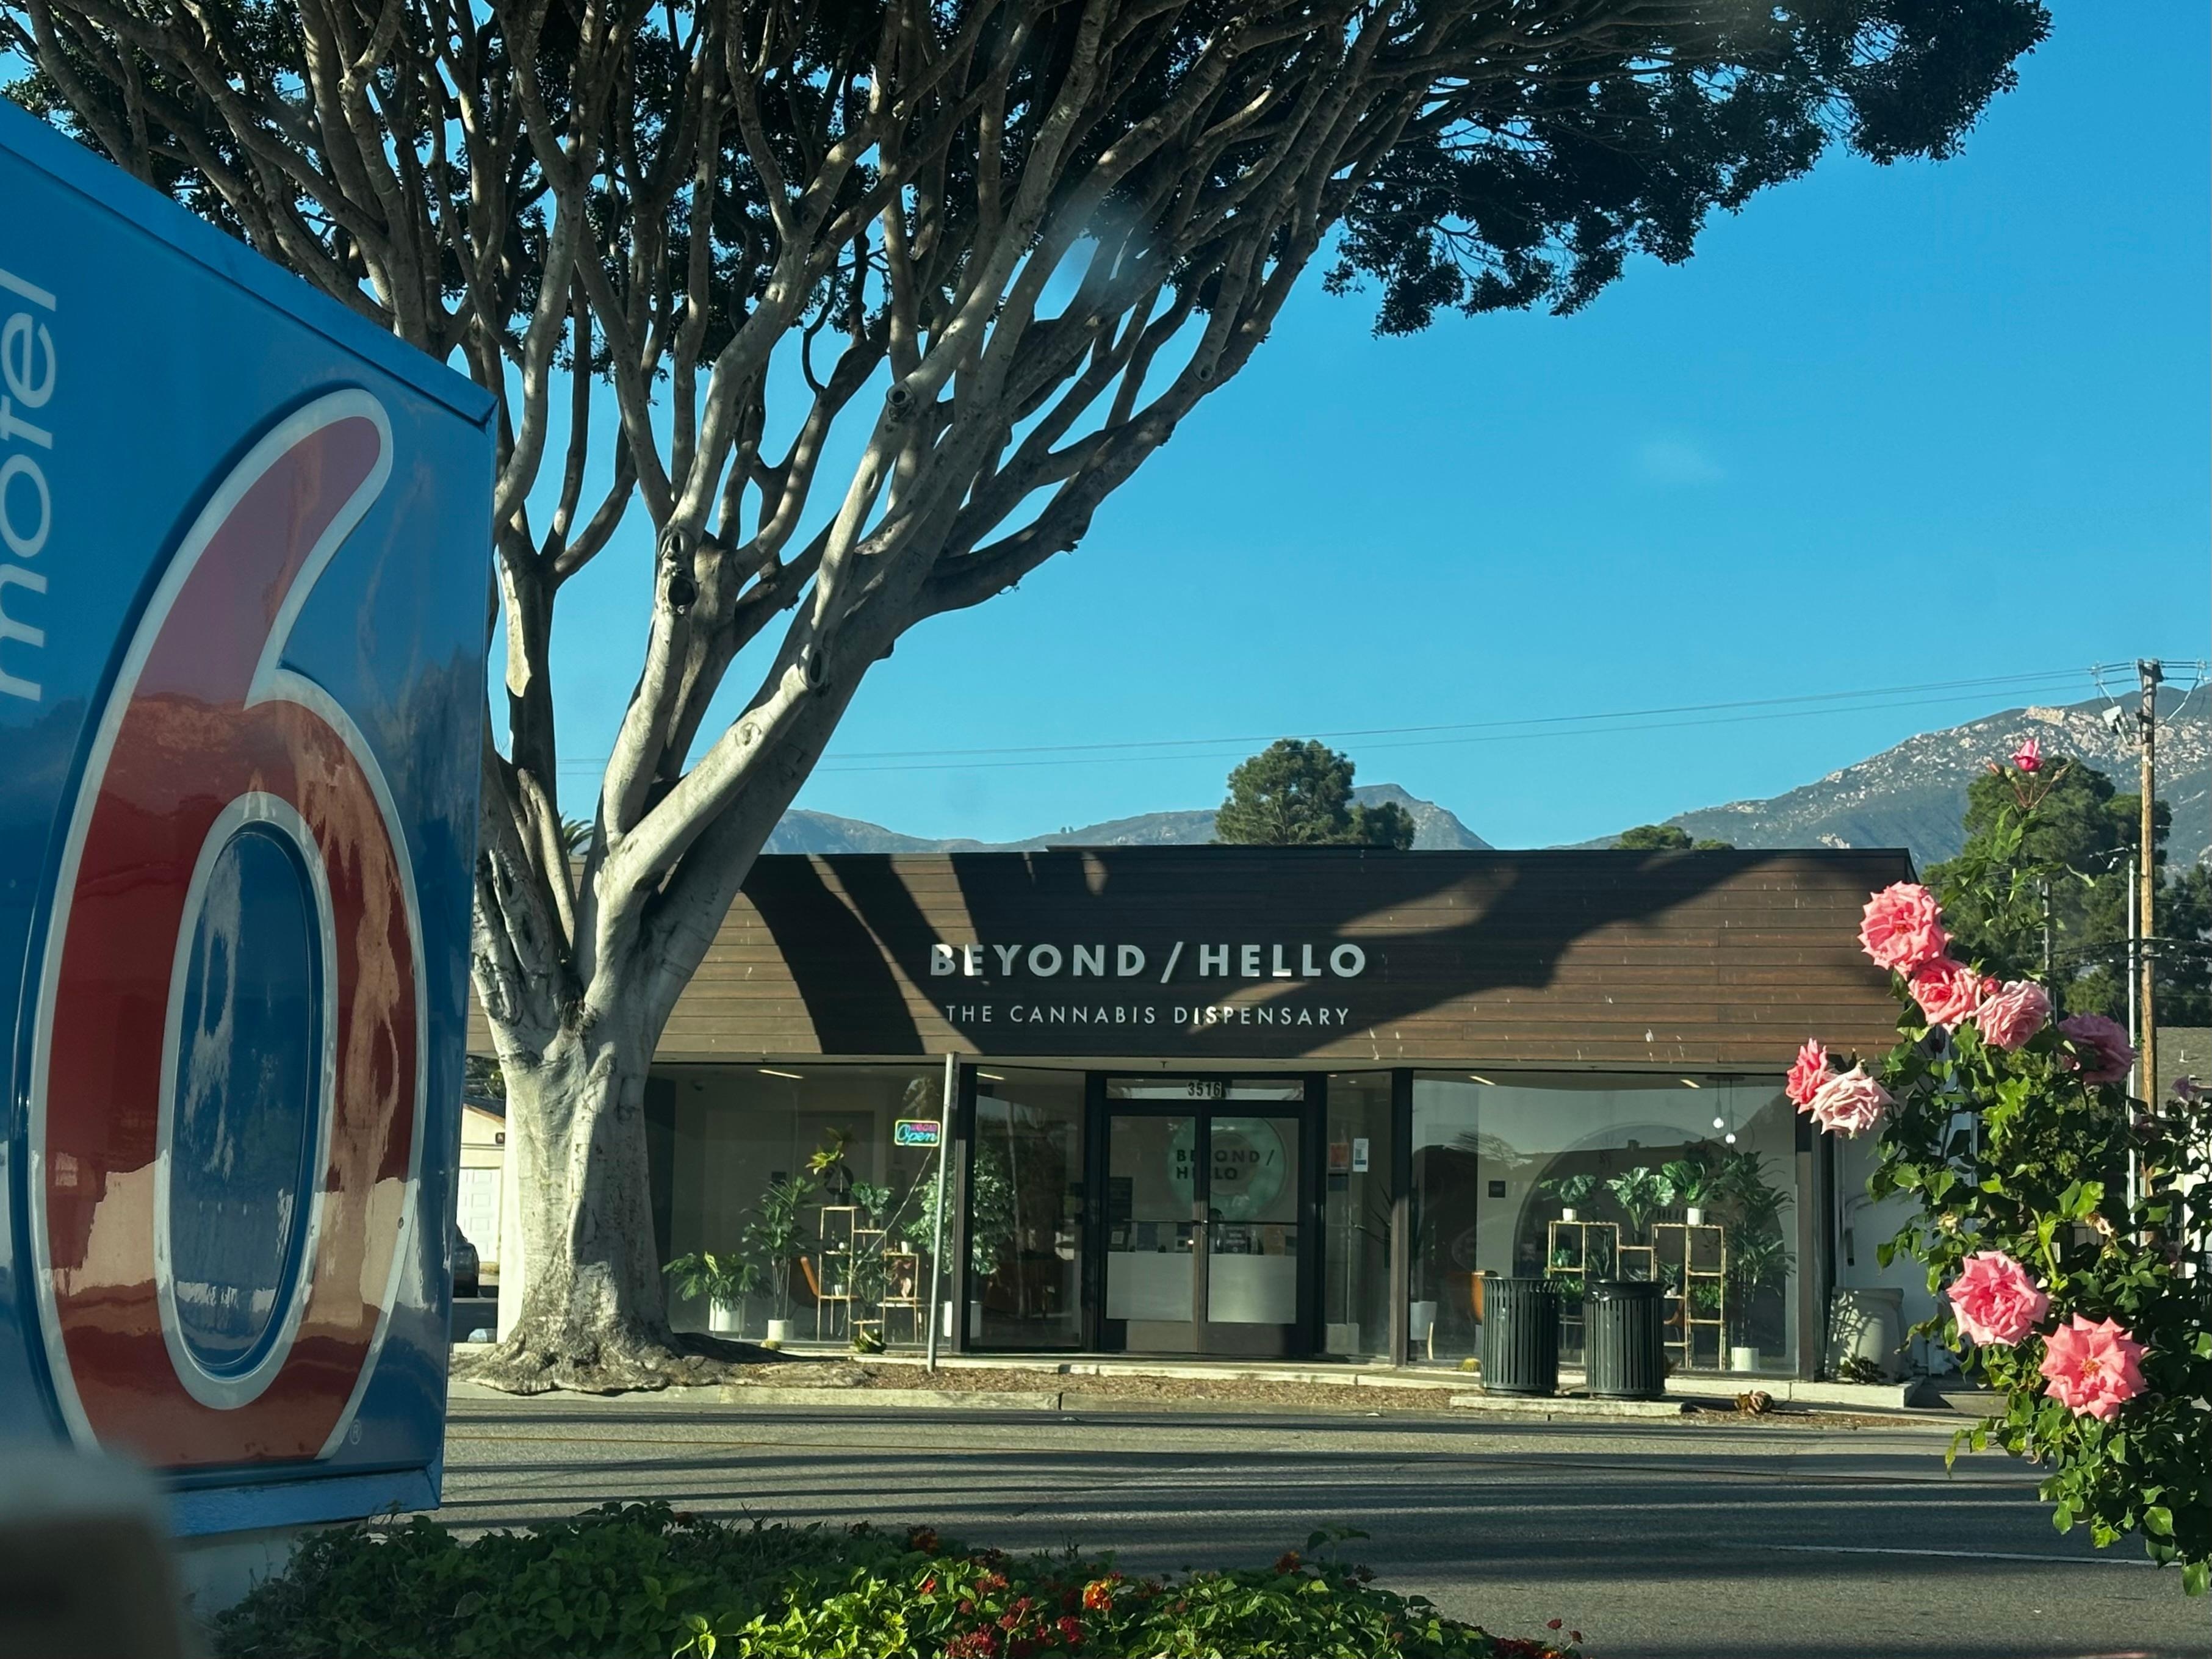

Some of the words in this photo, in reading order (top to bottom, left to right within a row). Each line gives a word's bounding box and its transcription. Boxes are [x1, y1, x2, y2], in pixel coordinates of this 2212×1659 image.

[29, 389, 426, 1461] 6
[931, 944, 1145, 977] BEYOND
[1199, 943, 1366, 977] HELLO
[946, 1006, 992, 1023] THE
[1010, 1006, 1155, 1024] CANNABIS
[1174, 1006, 1349, 1025] DISPENSARY
[1187, 1082, 1220, 1096] 3516
[897, 1124, 938, 1145] Open
[1176, 1149, 1260, 1163] BOND
[1176, 1166, 1238, 1180] HLO
